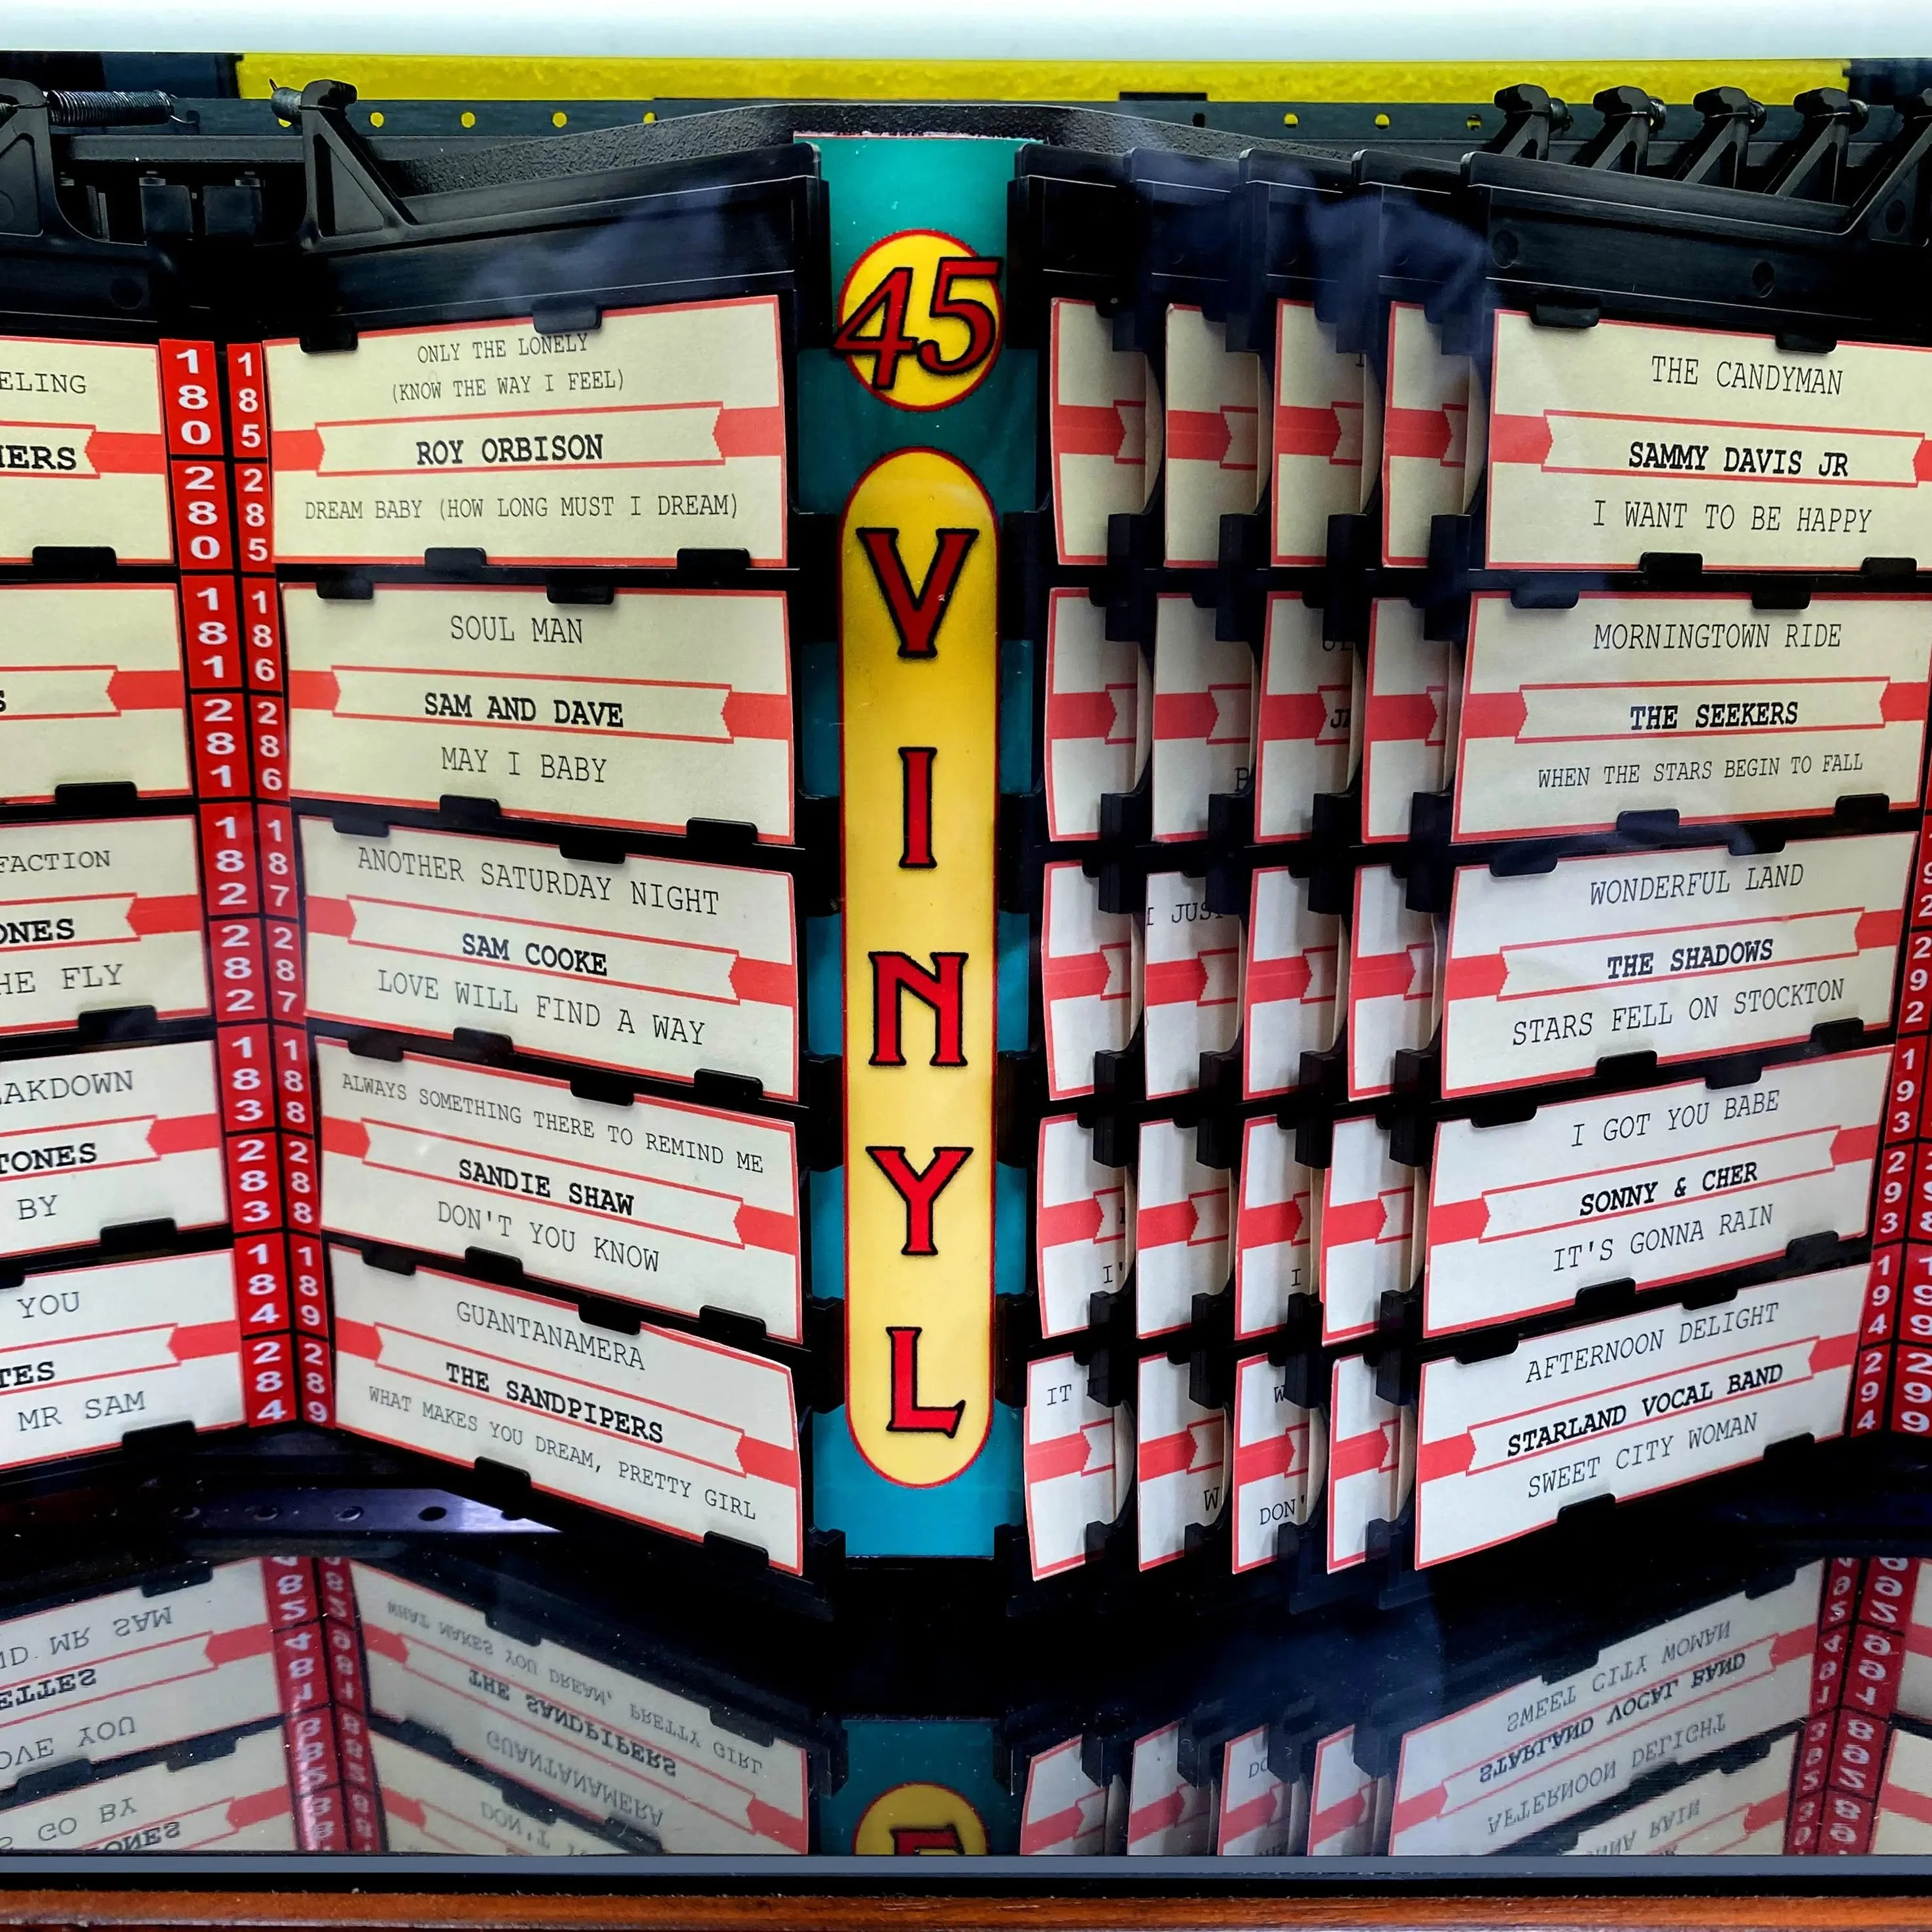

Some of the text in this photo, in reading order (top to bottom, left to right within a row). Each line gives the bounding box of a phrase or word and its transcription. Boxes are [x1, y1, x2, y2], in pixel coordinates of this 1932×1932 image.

[417, 332, 588, 364] ONLY THE LONELY
[833, 256, 1004, 391] 45
[176, 349, 211, 445] 180
[237, 352, 264, 448] 185
[393, 368, 624, 404] (KNOW THE WAY I FEEL)
[1651, 355, 1843, 395] THE CANDYMAN
[415, 433, 604, 466] ROY ORBISON
[1628, 441, 1849, 477] SAMMY DAVIS JR
[184, 466, 220, 559] 280
[243, 468, 268, 561] 285
[306, 493, 737, 521] DREAM BABY (HOW LONG MUST I DREAM)
[1592, 499, 1872, 533] I WANT TO BE HAPPY
[197, 587, 228, 678] 181
[252, 590, 275, 682] 186
[451, 615, 582, 644] SOUL MAN
[1593, 623, 1842, 650] MORNINGTOWN RIDE
[204, 699, 236, 788] 281
[258, 701, 282, 790] 286
[425, 692, 624, 728] SAM AND DAVE
[1630, 701, 1799, 731] THE SEEKERS
[441, 746, 607, 783] MAY I BABY
[1538, 753, 1863, 788] WHEN THE STARS BEGIN TO FALL
[215, 817, 247, 905] 182
[268, 819, 290, 907] 187
[358, 846, 719, 915] ANOTHER SATURDAY NIGHT
[1590, 863, 1804, 905] WONDERFUL LAND
[61, 963, 123, 990] FLY
[221, 924, 255, 1012] 282
[273, 926, 298, 1012] 287
[462, 932, 608, 977] SAM COOKE
[856, 527, 979, 1438] VINYL
[1607, 938, 1774, 979] THE SHADOWS
[1905, 936, 1932, 1023] 292
[378, 969, 705, 1045] LOVE WILL FIND A WAY
[1513, 977, 1845, 1046] STARS FELL ON STOCKTON
[0, 1070, 133, 1106] AKDOWN
[232, 1036, 263, 1121] 183
[283, 1039, 306, 1123] 188
[1893, 1049, 1914, 1133] 193
[342, 1073, 764, 1174] ALWAYS SOMETHING THERE TO REMIND ME
[1571, 1089, 1780, 1148] I GOT YOU BABE
[16, 1194, 58, 1220] BY
[237, 1139, 270, 1222] 283
[289, 1140, 313, 1223] 288
[459, 1158, 635, 1216] SANDIE SHAW
[1579, 1161, 1758, 1217] SONNY & CHER
[1880, 1151, 1906, 1233] 293
[438, 1201, 659, 1273] DON'T YOU KNOW
[1553, 1203, 1774, 1272] IT'S GONNA RAIN
[16, 1291, 79, 1319] YOU
[248, 1243, 279, 1324] 184
[298, 1246, 320, 1326] 189
[1868, 1255, 1890, 1334] 194
[457, 1301, 646, 1371] GUANTANAMERA
[1524, 1301, 1780, 1384] AFTERNOON DELIGHT
[17, 1390, 146, 1431] MR SAM
[253, 1341, 286, 1420] 284
[304, 1343, 327, 1422] 289
[446, 1361, 663, 1444] THE SANDPIPERS
[1507, 1363, 1783, 1458] STARLAND VOCAL BAND
[1857, 1352, 1882, 1428] 294
[1901, 1352, 1932, 1432] 299
[369, 1386, 756, 1520] WHAT MAKES YOU DREAM, PRETTY GIRL
[1528, 1411, 1758, 1498] SWEET CITY WOMAN
